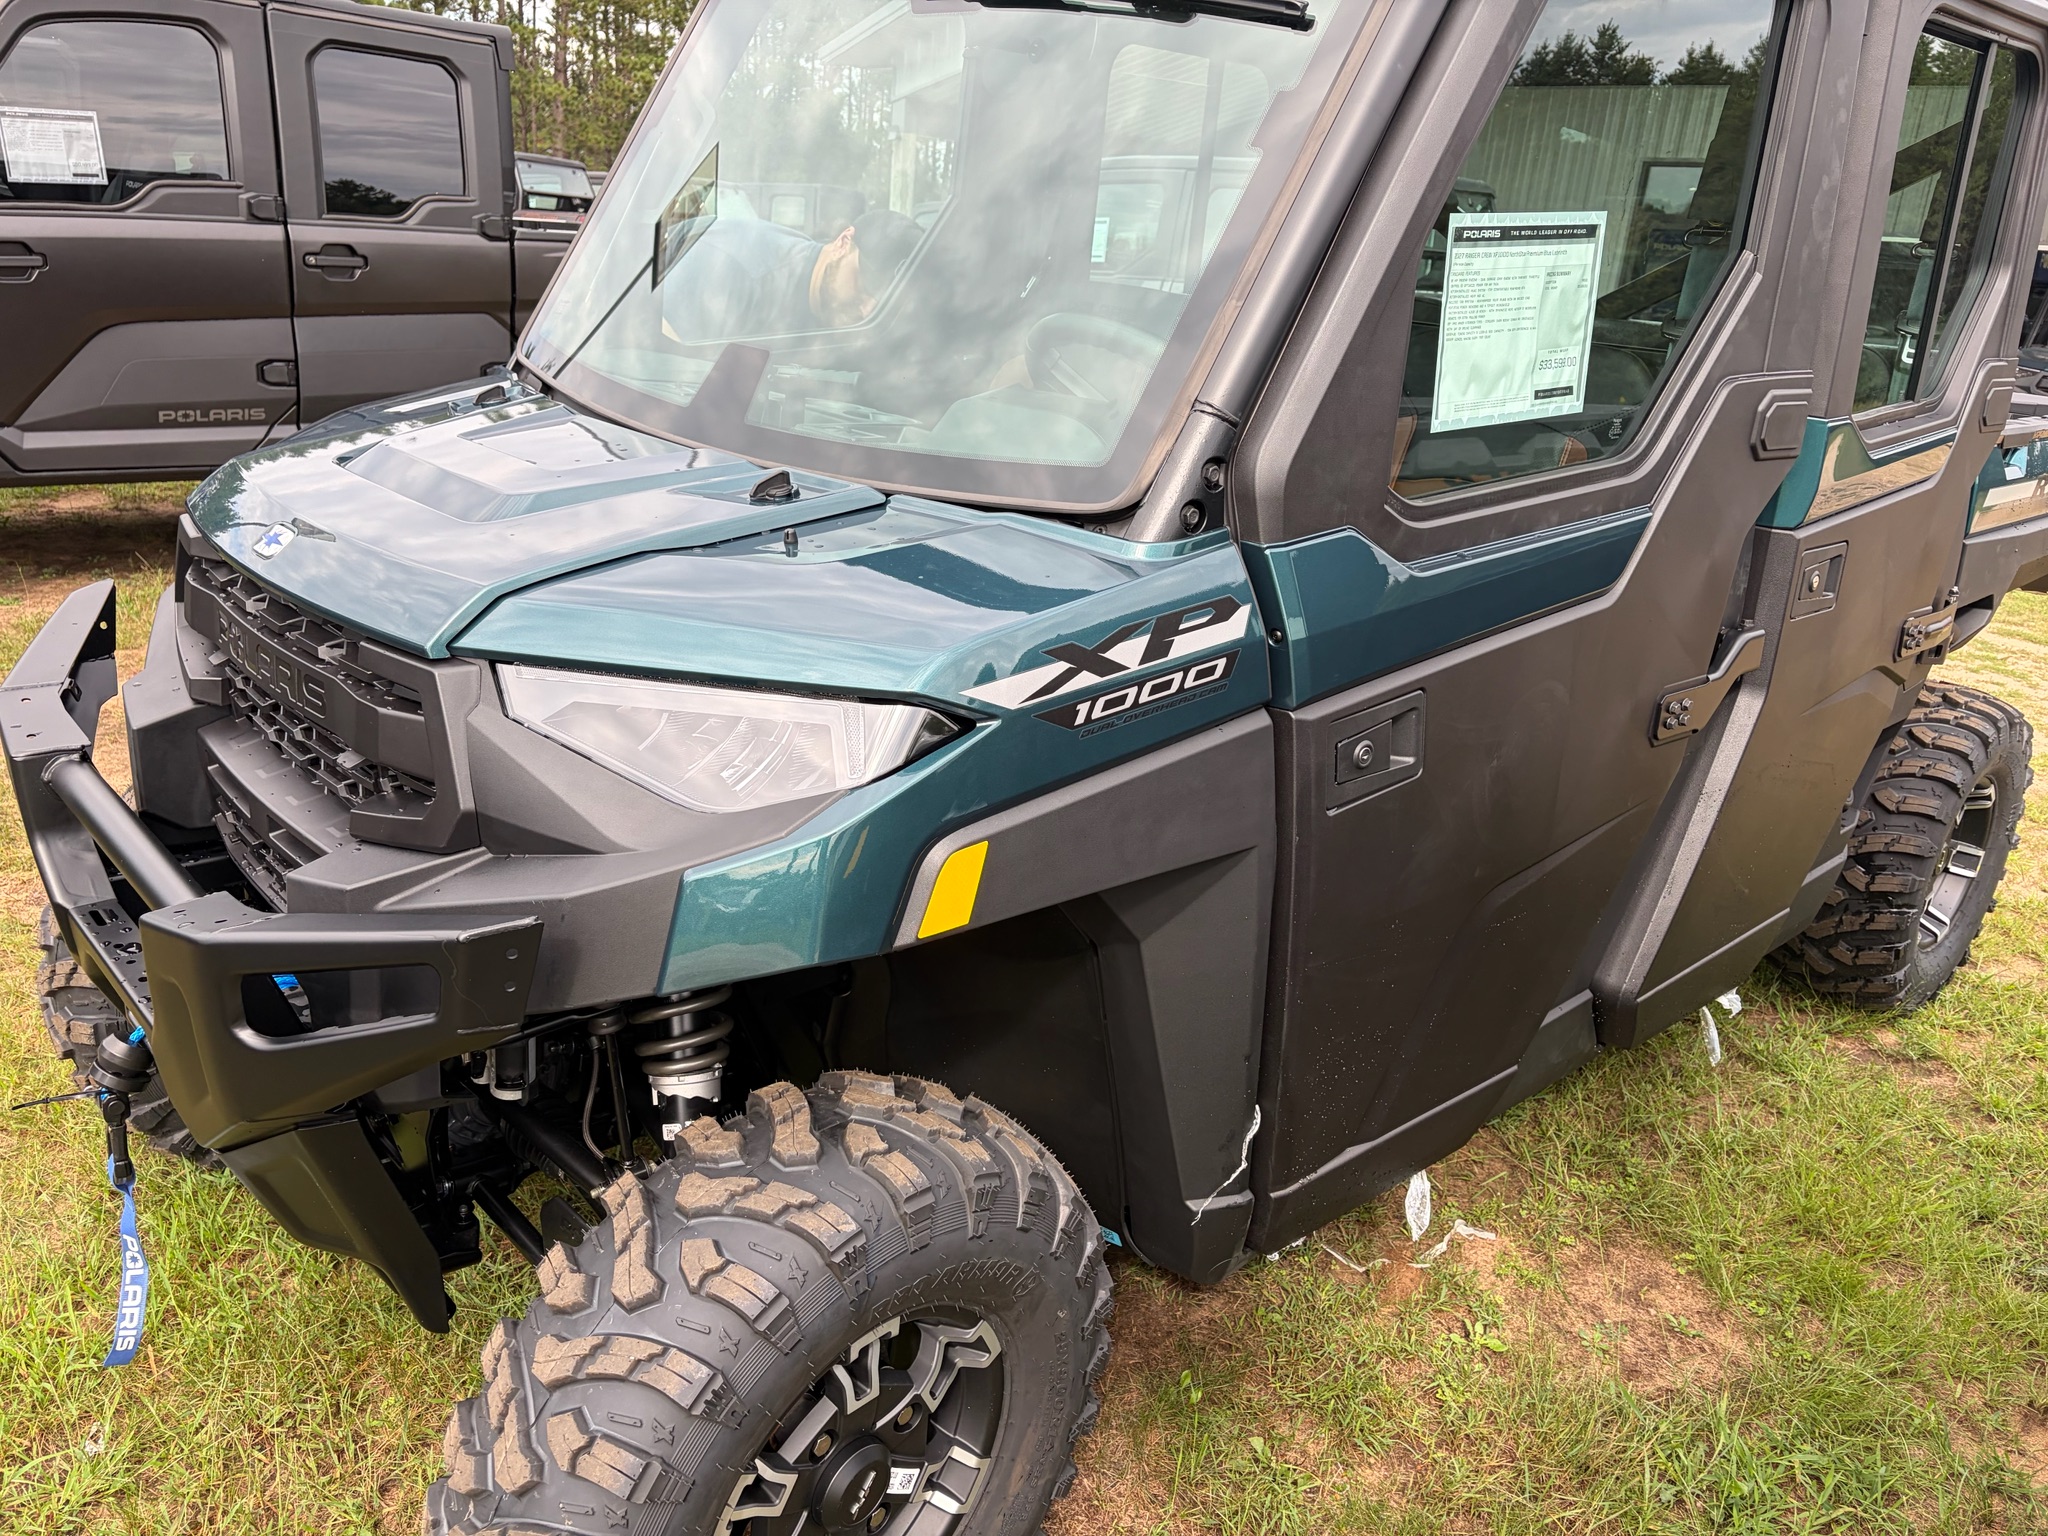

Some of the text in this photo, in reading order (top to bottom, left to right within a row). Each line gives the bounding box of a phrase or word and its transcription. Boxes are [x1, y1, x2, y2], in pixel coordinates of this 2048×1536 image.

[1463, 229, 1501, 239] POLARIS
[158, 408, 266, 423] POLARIS
[218, 608, 327, 719] POLARIS
[1017, 594, 1243, 705] XP
[1073, 656, 1228, 727] 1000
[115, 1233, 144, 1351] POLARIS
